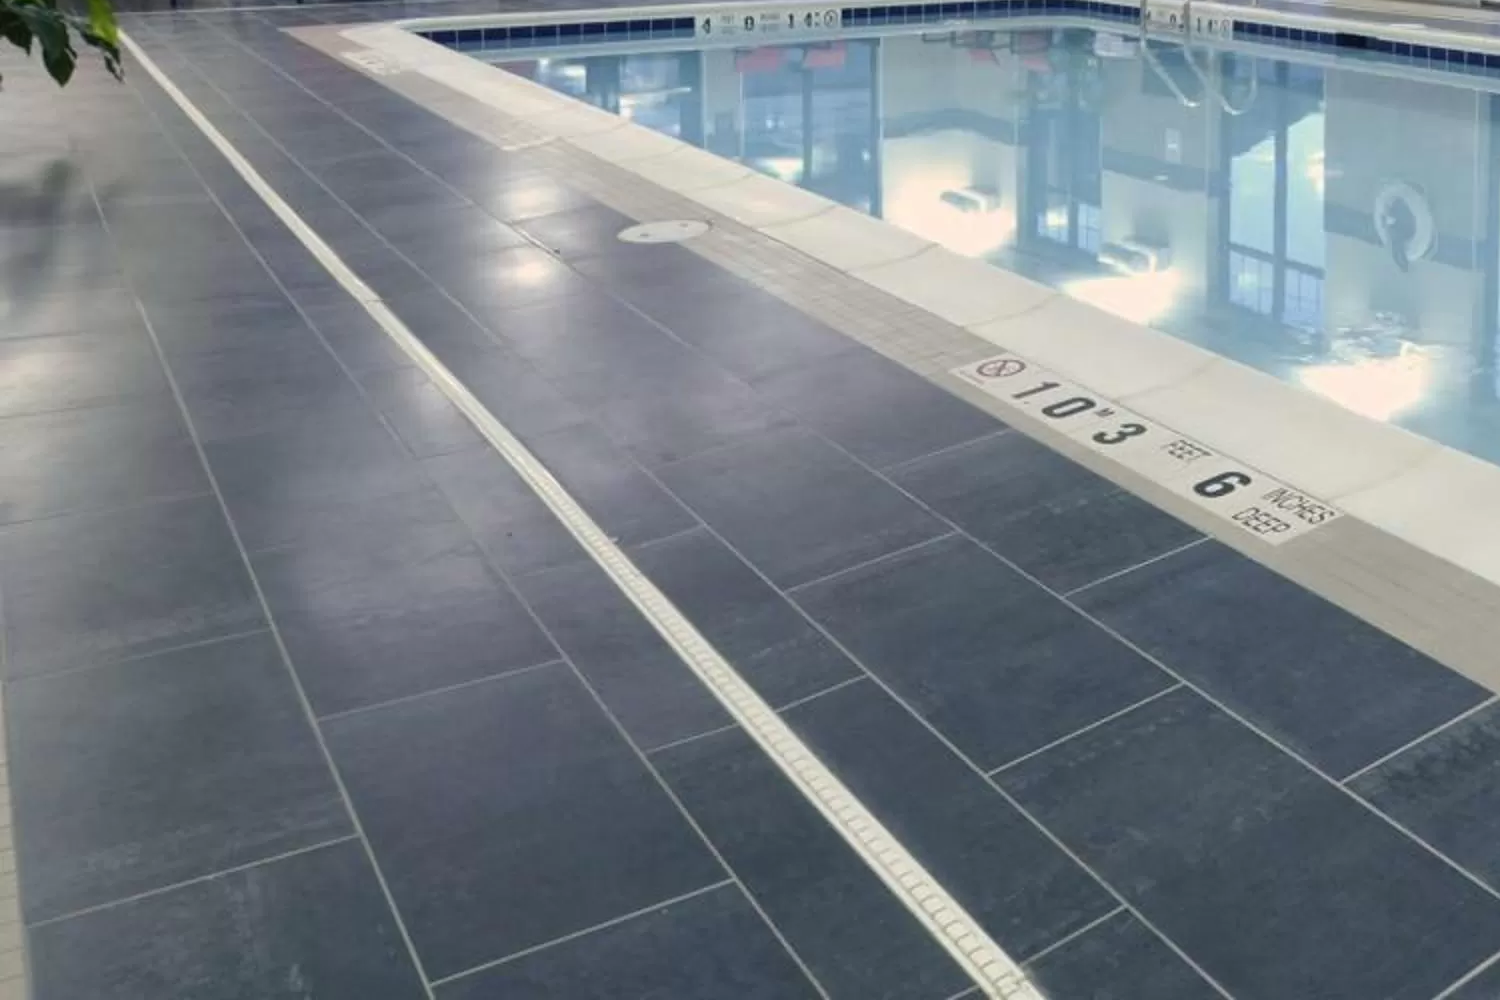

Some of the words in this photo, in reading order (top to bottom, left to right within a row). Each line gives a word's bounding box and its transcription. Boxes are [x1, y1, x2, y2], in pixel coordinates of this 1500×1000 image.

[1092, 423, 1147, 445] 3
[1193, 471, 1252, 498] 6
[1262, 488, 1335, 525] INCHES
[1232, 507, 1291, 534] DEEP
